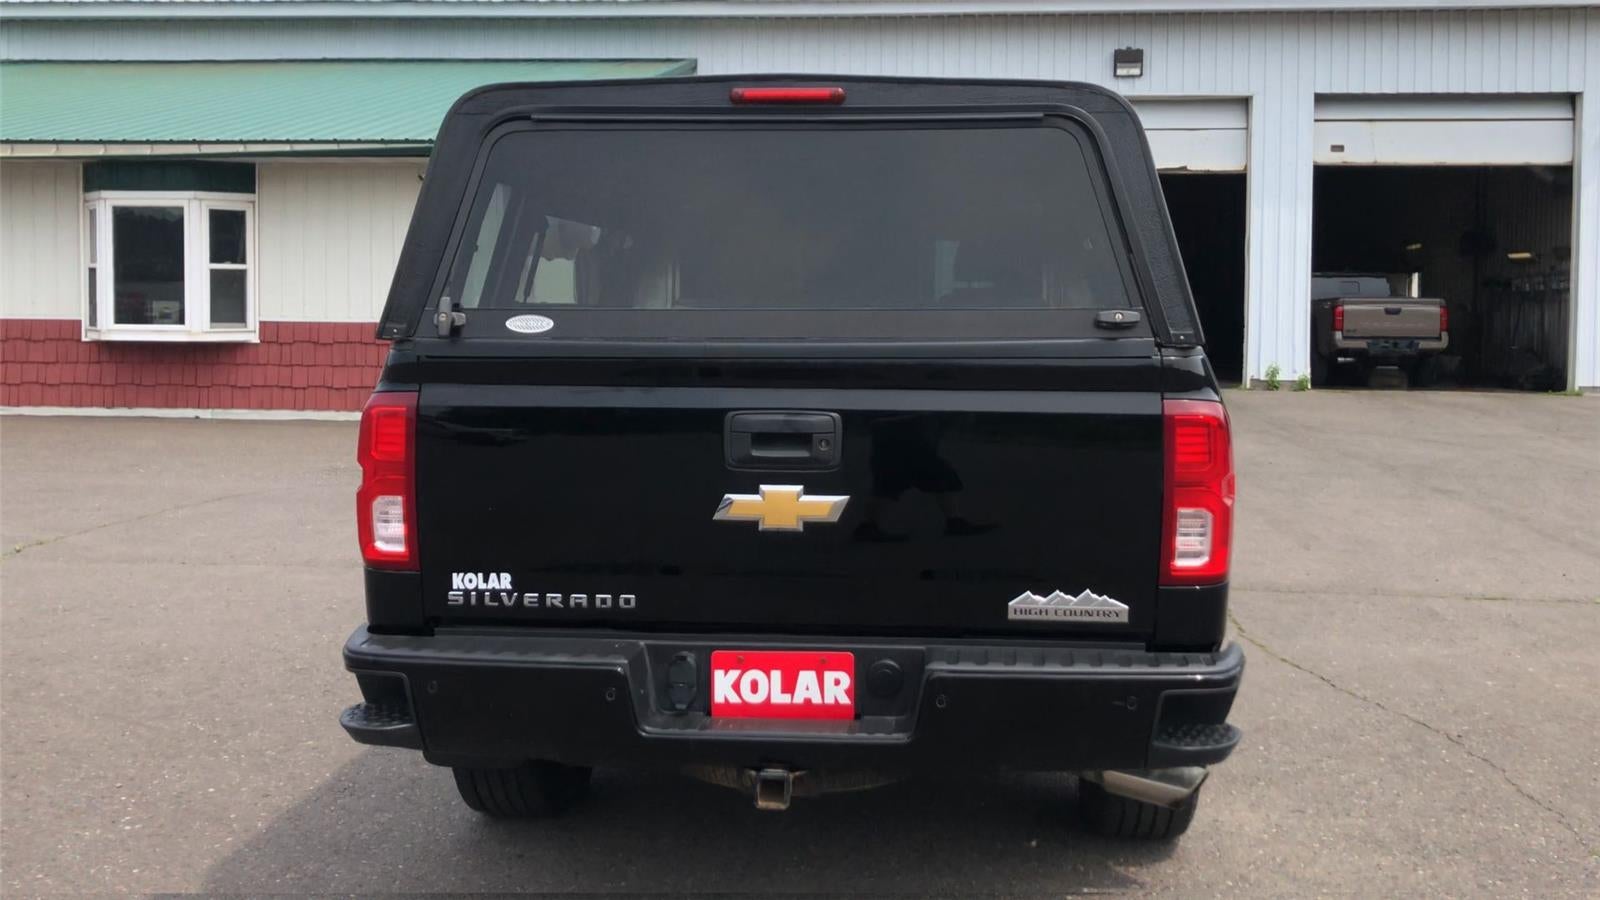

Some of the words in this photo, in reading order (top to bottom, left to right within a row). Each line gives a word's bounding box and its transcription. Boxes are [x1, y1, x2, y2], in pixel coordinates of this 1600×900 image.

[452, 572, 512, 590] KOLAR
[448, 591, 636, 609] SILVERADO
[1013, 608, 1049, 616] HIGH
[1054, 609, 1120, 618] COUNTRY
[713, 669, 851, 704] KOLAR
